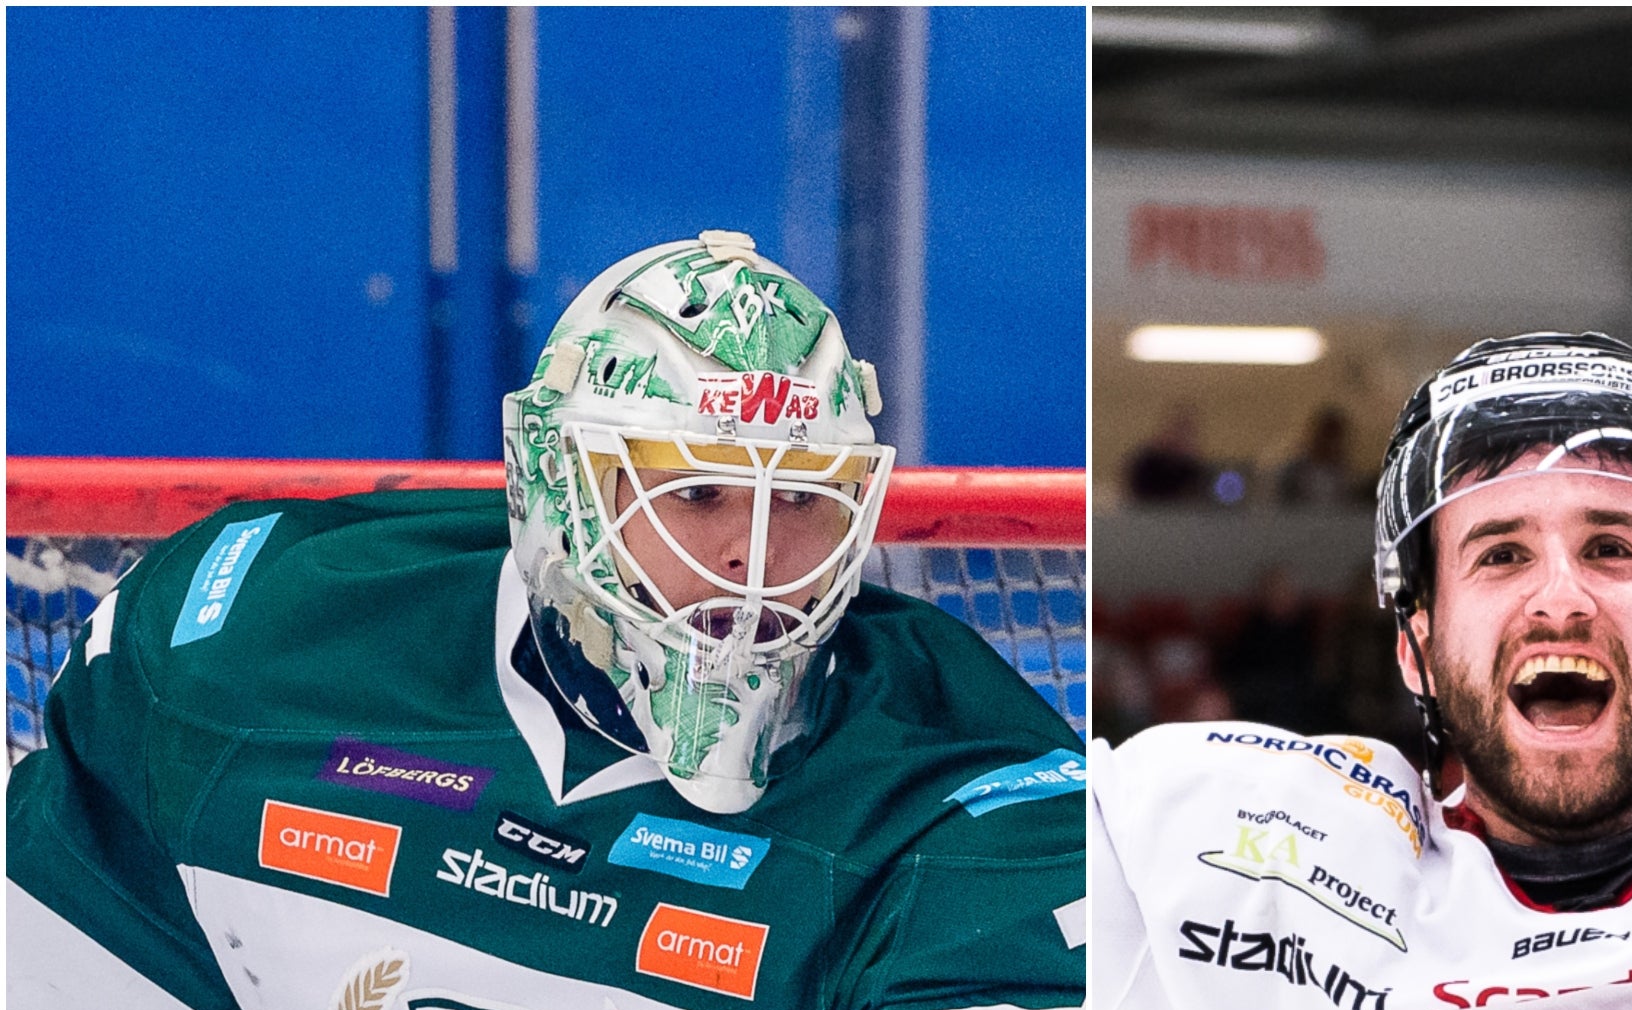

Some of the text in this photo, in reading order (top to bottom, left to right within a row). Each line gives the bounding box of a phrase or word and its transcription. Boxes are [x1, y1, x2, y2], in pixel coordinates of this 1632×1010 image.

[217, 526, 261, 576] Svema
[206, 576, 233, 601] Bil
[1206, 731, 1348, 771] NORDIC
[336, 756, 474, 792] LÖFBERGS
[279, 826, 376, 864] armat
[497, 817, 586, 865] CCM
[630, 826, 696, 857] Svema
[700, 841, 728, 864] Bil
[1233, 824, 1298, 868] KA
[435, 848, 618, 928] stadium
[1307, 864, 1397, 926] project
[656, 928, 745, 968] armat
